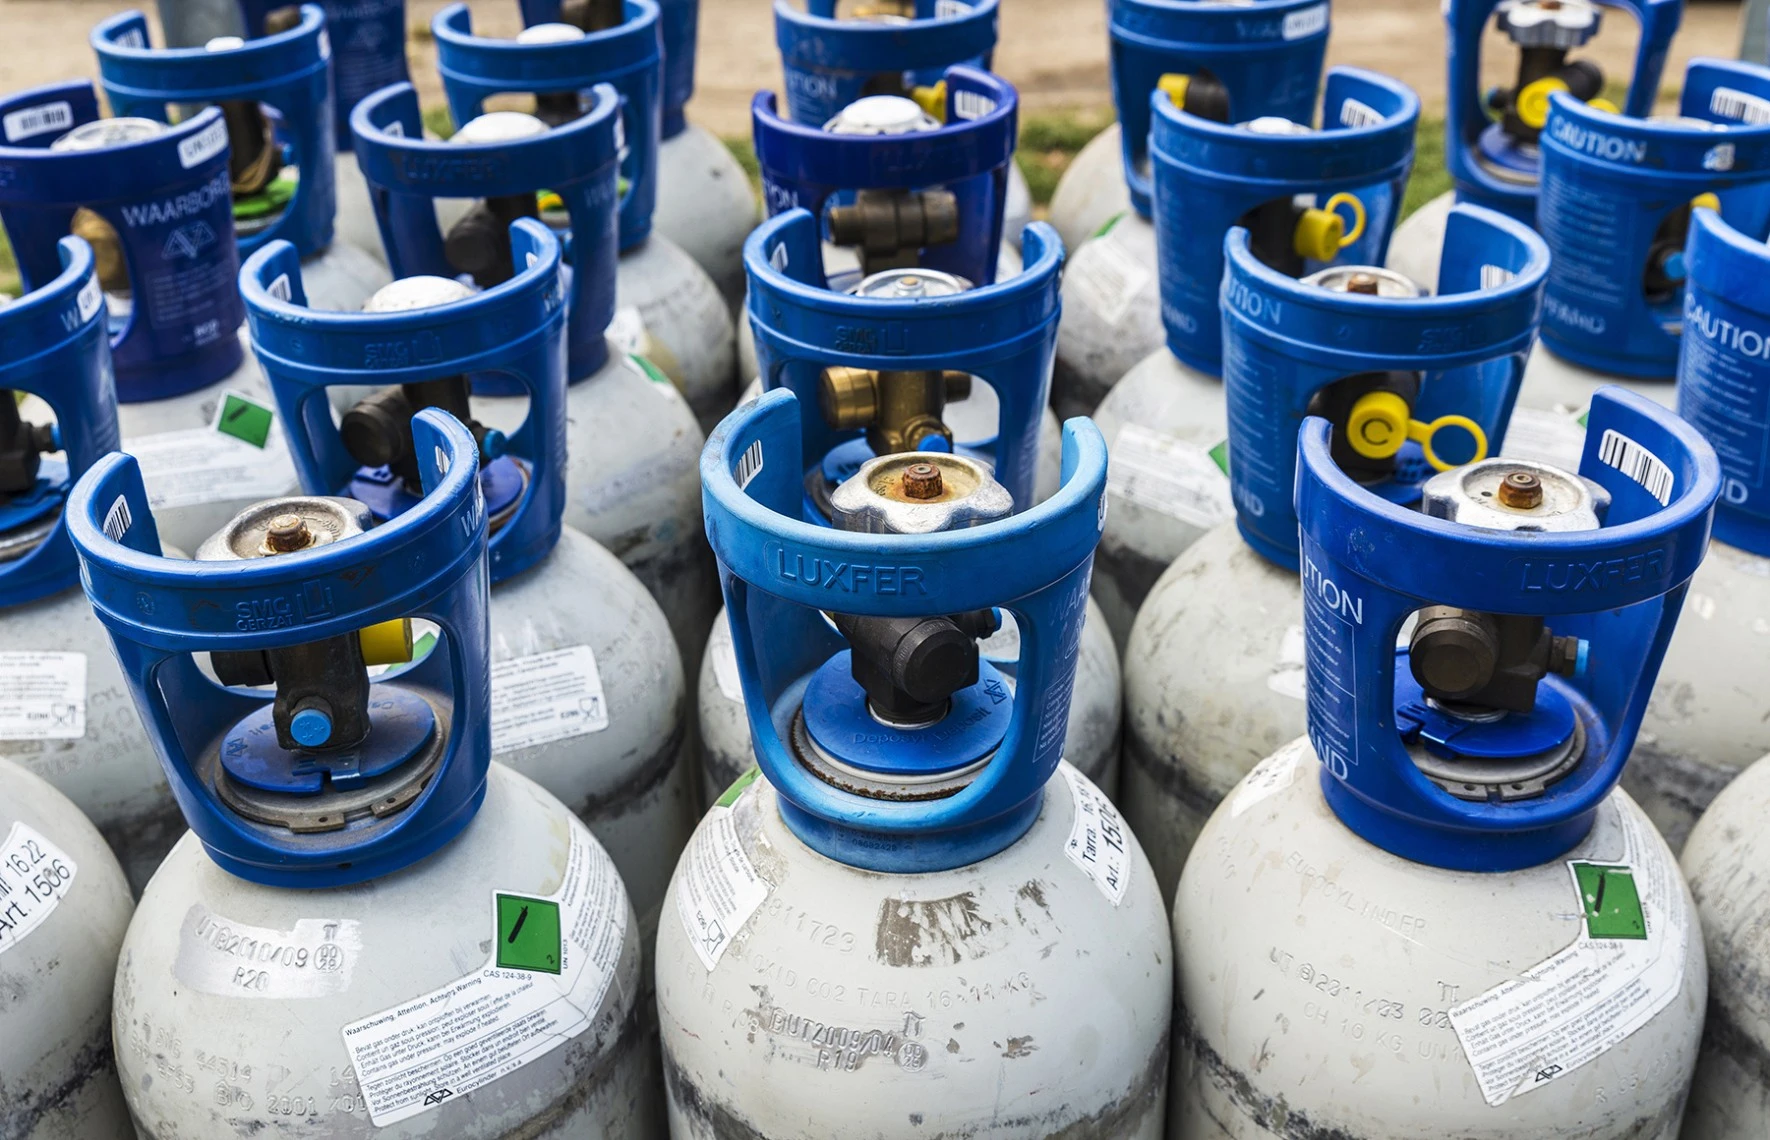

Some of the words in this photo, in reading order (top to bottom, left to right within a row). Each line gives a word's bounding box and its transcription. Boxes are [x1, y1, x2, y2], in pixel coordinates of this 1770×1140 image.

[1550, 114, 1648, 162] CAUTION
[778, 549, 927, 595] LUXFER
[1521, 549, 1664, 591] LUXFER
[236, 597, 290, 618] SMG
[236, 614, 293, 631] GERZAT
[25, 858, 70, 903] 1506
[546, 954, 555, 965] 2
[456, 978, 482, 992] Warning
[483, 969, 500, 979] CAS
[502, 971, 532, 981] 124-38-9
[857, 986, 912, 1009] TARA
[456, 1072, 497, 1094] Eurocylinder
